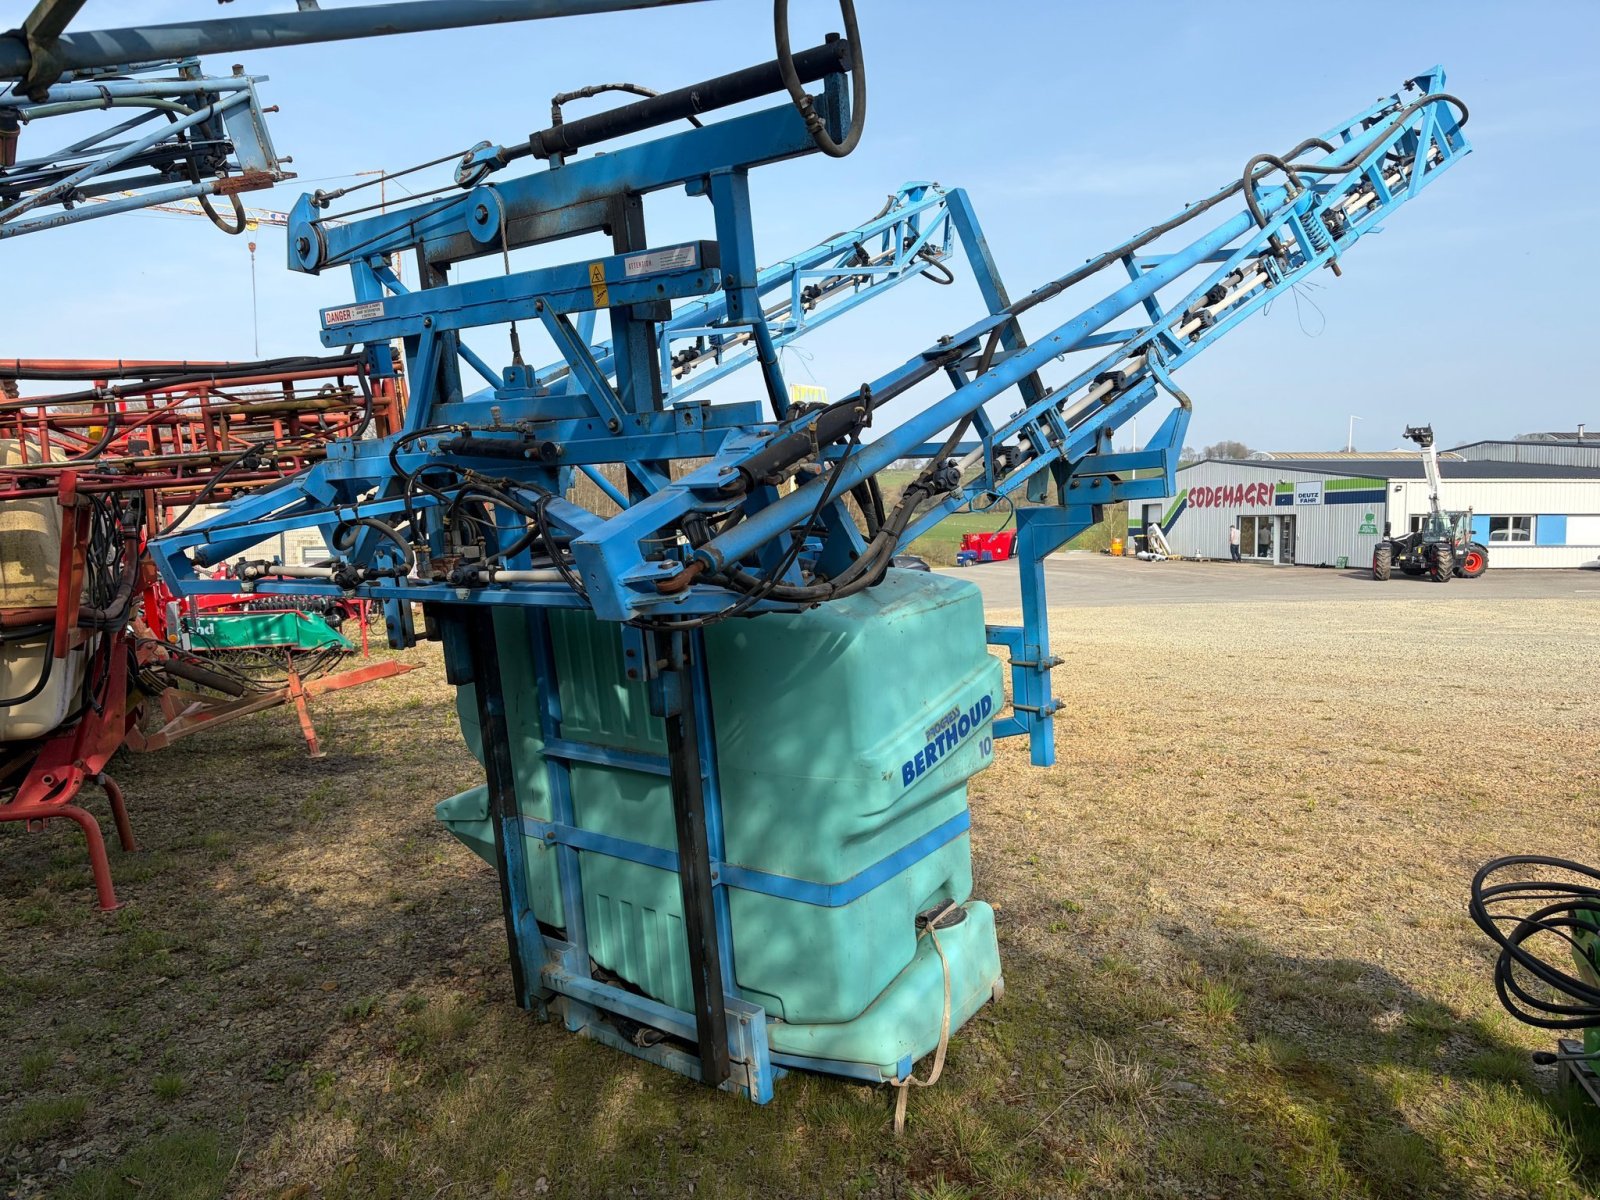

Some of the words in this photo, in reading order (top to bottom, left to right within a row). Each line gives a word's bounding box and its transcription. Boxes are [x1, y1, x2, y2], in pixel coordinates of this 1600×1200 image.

[1188, 482, 1275, 508] SODEMAGRI
[901, 694, 992, 788] BERTHOUD
[979, 736, 992, 759] 10
